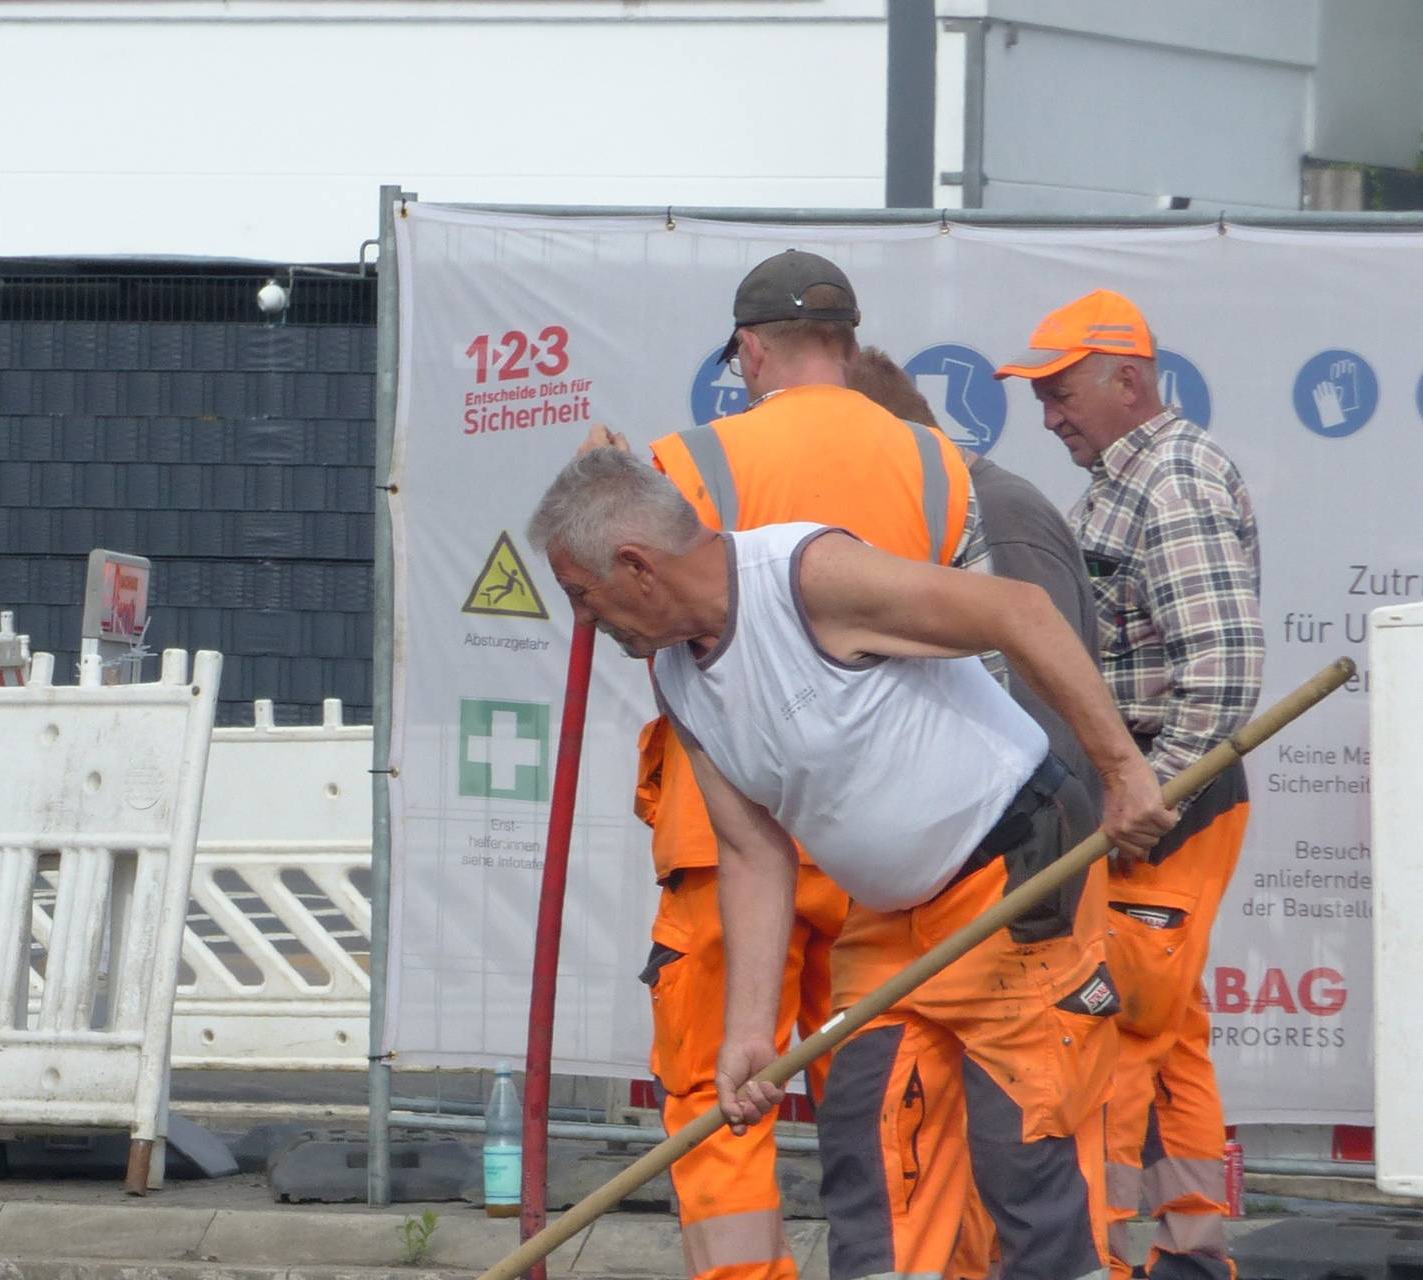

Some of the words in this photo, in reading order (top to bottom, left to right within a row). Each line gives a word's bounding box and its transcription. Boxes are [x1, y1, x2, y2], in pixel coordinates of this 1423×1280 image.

[464, 385, 537, 406] Entscheide
[539, 381, 568, 397] Dich
[570, 378, 593, 394] für
[463, 395, 591, 435] Sicherheit
[1348, 565, 1423, 596] Zutr
[1284, 612, 1334, 644] für
[464, 632, 550, 652] Absturzgefahr
[1279, 745, 1337, 765] Keine
[461, 854, 494, 868] siehe
[1242, 898, 1275, 917] der
[1212, 1027, 1346, 1048] PROGRESS
